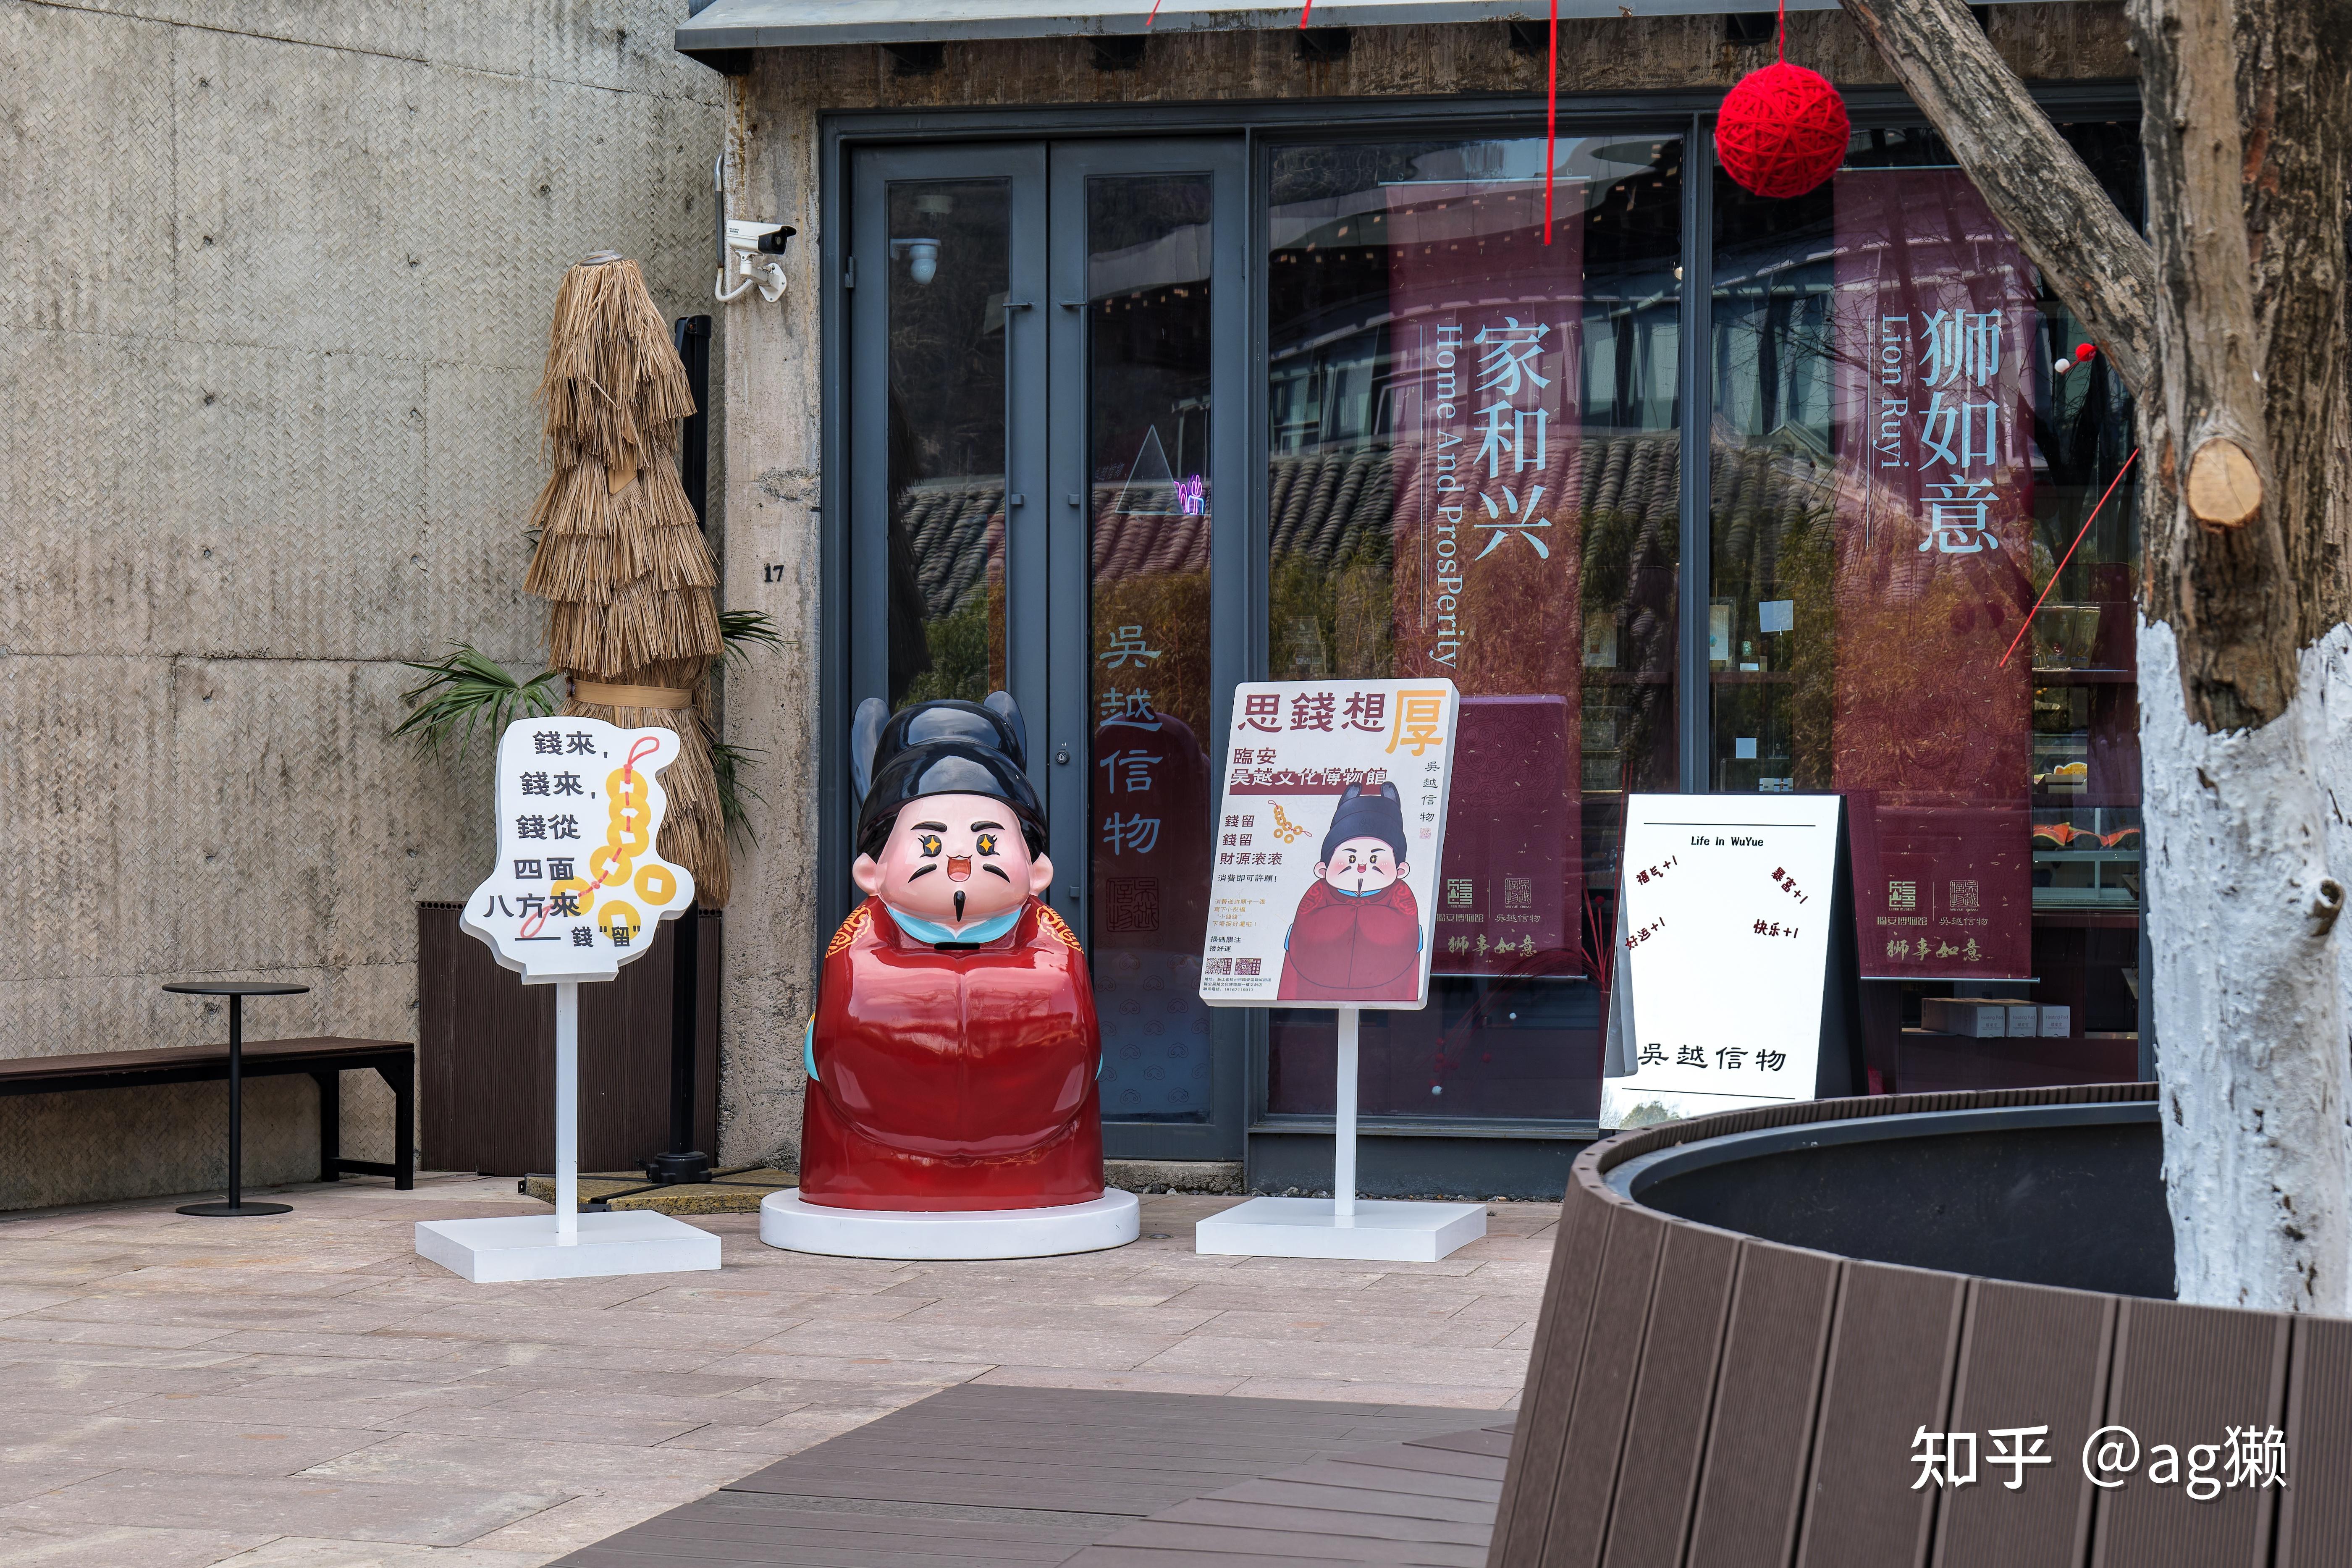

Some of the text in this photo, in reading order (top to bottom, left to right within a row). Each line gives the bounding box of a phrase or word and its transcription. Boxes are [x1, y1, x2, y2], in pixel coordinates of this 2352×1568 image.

[1436, 323, 1463, 419] Home
[1872, 313, 1911, 468] Lion Ruyi
[1473, 316, 1551, 561] 家和兴
[1918, 308, 2003, 553] 狮如意
[1436, 432, 1463, 493] And
[764, 563, 784, 582] 17
[1238, 690, 1447, 757] 思錢想厚
[1232, 747, 1277, 765] 臨安
[1230, 767, 1387, 786] 吴越文化博物館
[515, 814, 581, 840] 錢從
[1225, 814, 1255, 828] 錢留
[1222, 833, 1253, 847] 錢留
[1691, 836, 1764, 847] Life In WuYue
[513, 857, 575, 881] 四面
[1636, 855, 1678, 886] 福气+1
[1771, 866, 1808, 904] 暴富+1
[483, 893, 582, 918] 八方來
[1625, 917, 1665, 950] 好运+1
[1753, 918, 1799, 939] 快乐+1
